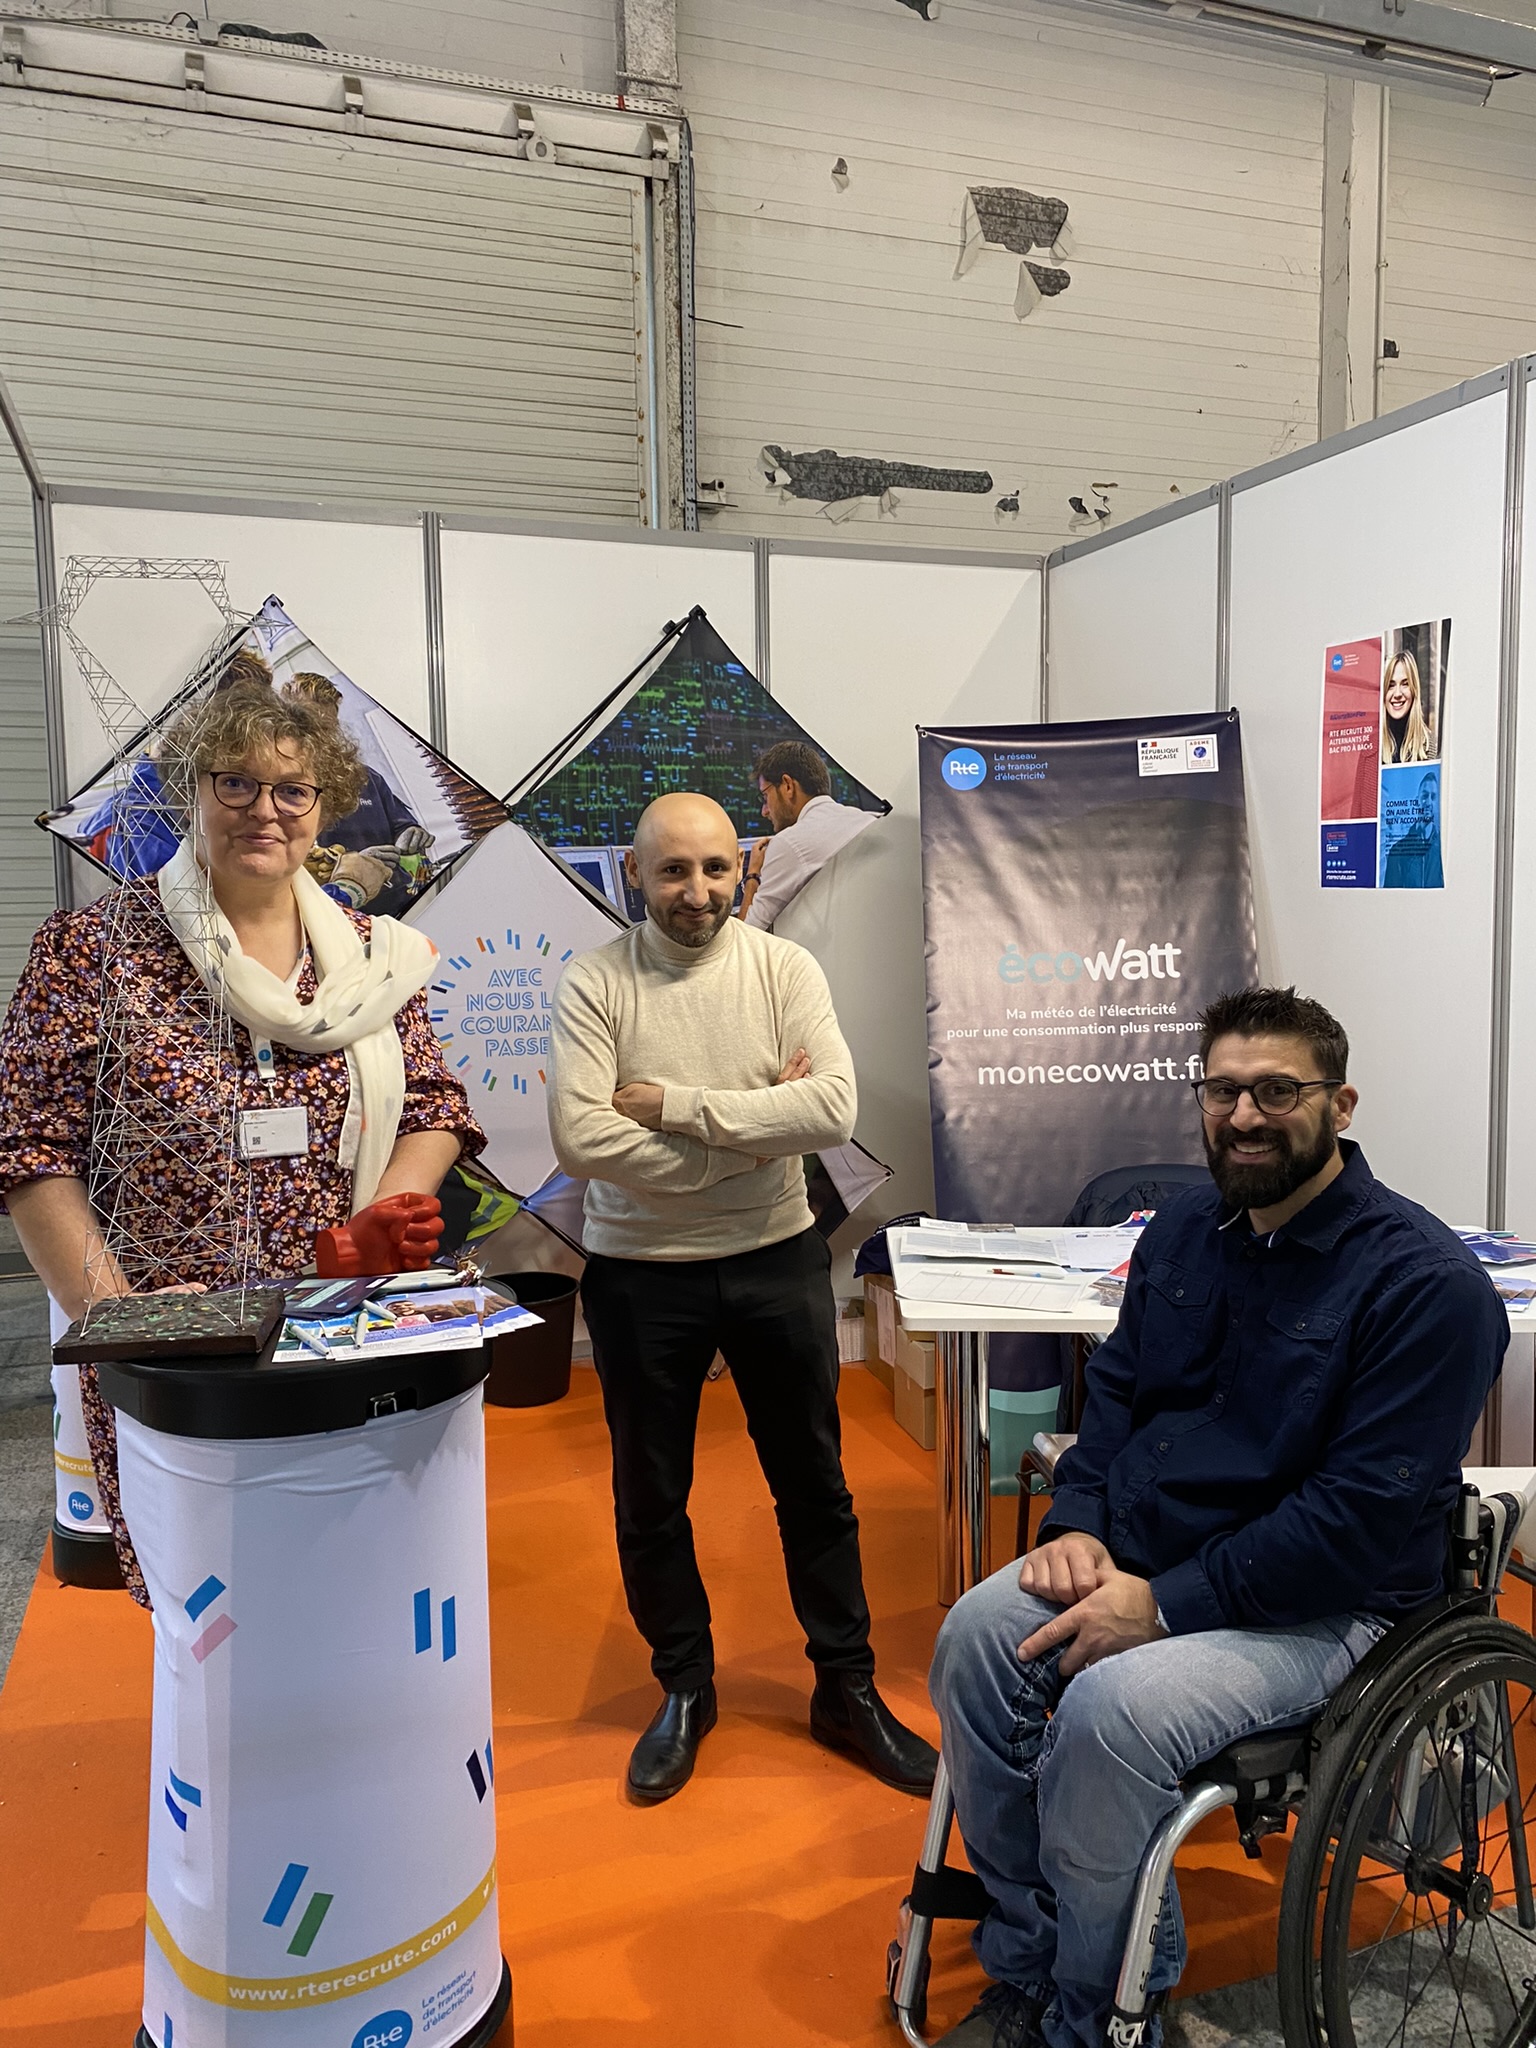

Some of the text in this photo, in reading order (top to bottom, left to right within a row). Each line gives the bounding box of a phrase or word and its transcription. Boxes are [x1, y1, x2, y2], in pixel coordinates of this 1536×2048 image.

[1340, 727, 1363, 736] RECRUTE
[1007, 752, 1036, 760] réseau
[1141, 747, 1179, 755] RÉPUBLIQUE
[1141, 754, 1177, 762] FRANÇAISE
[950, 760, 979, 775] Rte
[1007, 761, 1048, 771] transport
[994, 771, 1045, 780] d'électricité
[1386, 799, 1408, 807] COMME
[1396, 808, 1410, 816] AIME
[998, 938, 1181, 983] écowatt
[488, 967, 543, 988] AVEC
[467, 992, 552, 1012] NOUS L
[1006, 1002, 1177, 1019] Ma météo de l'électricité
[461, 1014, 552, 1035] COURAN
[946, 1029, 979, 1040] pour
[983, 1028, 1008, 1037] une
[1012, 1023, 1116, 1036] consommation
[1120, 1017, 1150, 1036] plus
[486, 1036, 550, 1057] PASSE
[72, 1499, 89, 1512] Rte
[229, 1920, 457, 2001] www.rterecrute.com
[422, 1970, 467, 2009] Le réseau
[423, 1970, 476, 2020] de transport
[363, 2026, 403, 2048] Rte
